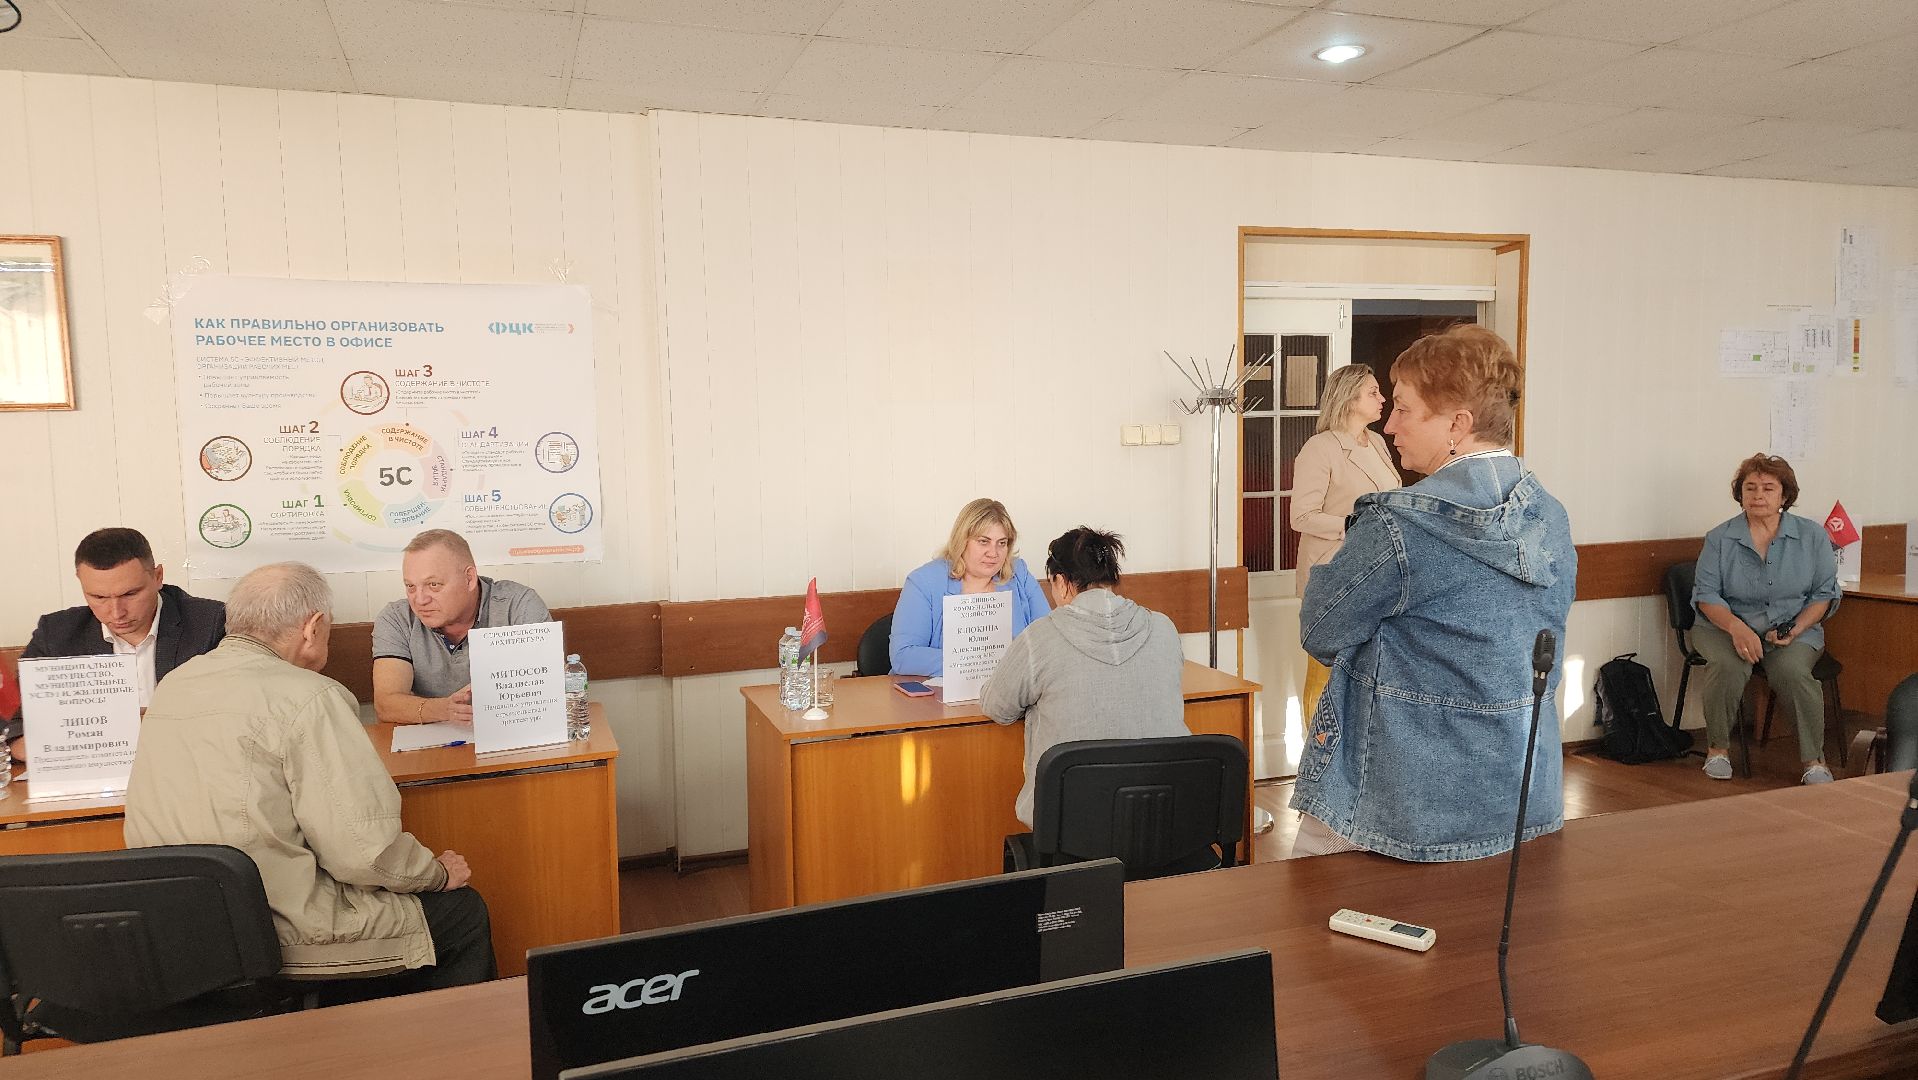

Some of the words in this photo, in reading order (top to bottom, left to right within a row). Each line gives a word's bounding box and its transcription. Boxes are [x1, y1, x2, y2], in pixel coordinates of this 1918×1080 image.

[194, 317, 226, 329] КАК
[230, 318, 327, 331] ПРАВИЛЬНО
[330, 320, 445, 333] ОРГАНИЗОВАТЬ
[195, 335, 267, 346] РАБОЧЕЕ
[270, 335, 322, 347] МЕСТО
[326, 337, 336, 347] В
[339, 336, 393, 348] ОФИСЕ
[395, 368, 420, 377] ШАГ
[423, 364, 433, 378] 3
[279, 424, 306, 433] ШАГ
[308, 420, 320, 433] 2
[461, 430, 485, 439] ШАГ
[488, 426, 498, 439] 4
[379, 466, 413, 487] 5С
[282, 499, 308, 508] ШАГ
[313, 494, 324, 508] 1
[464, 494, 489, 503] ШАГ
[491, 489, 502, 502] 5
[67, 730, 104, 740] Роман
[582, 969, 700, 1016] acer
[1515, 1057, 1565, 1080] BOSCH
